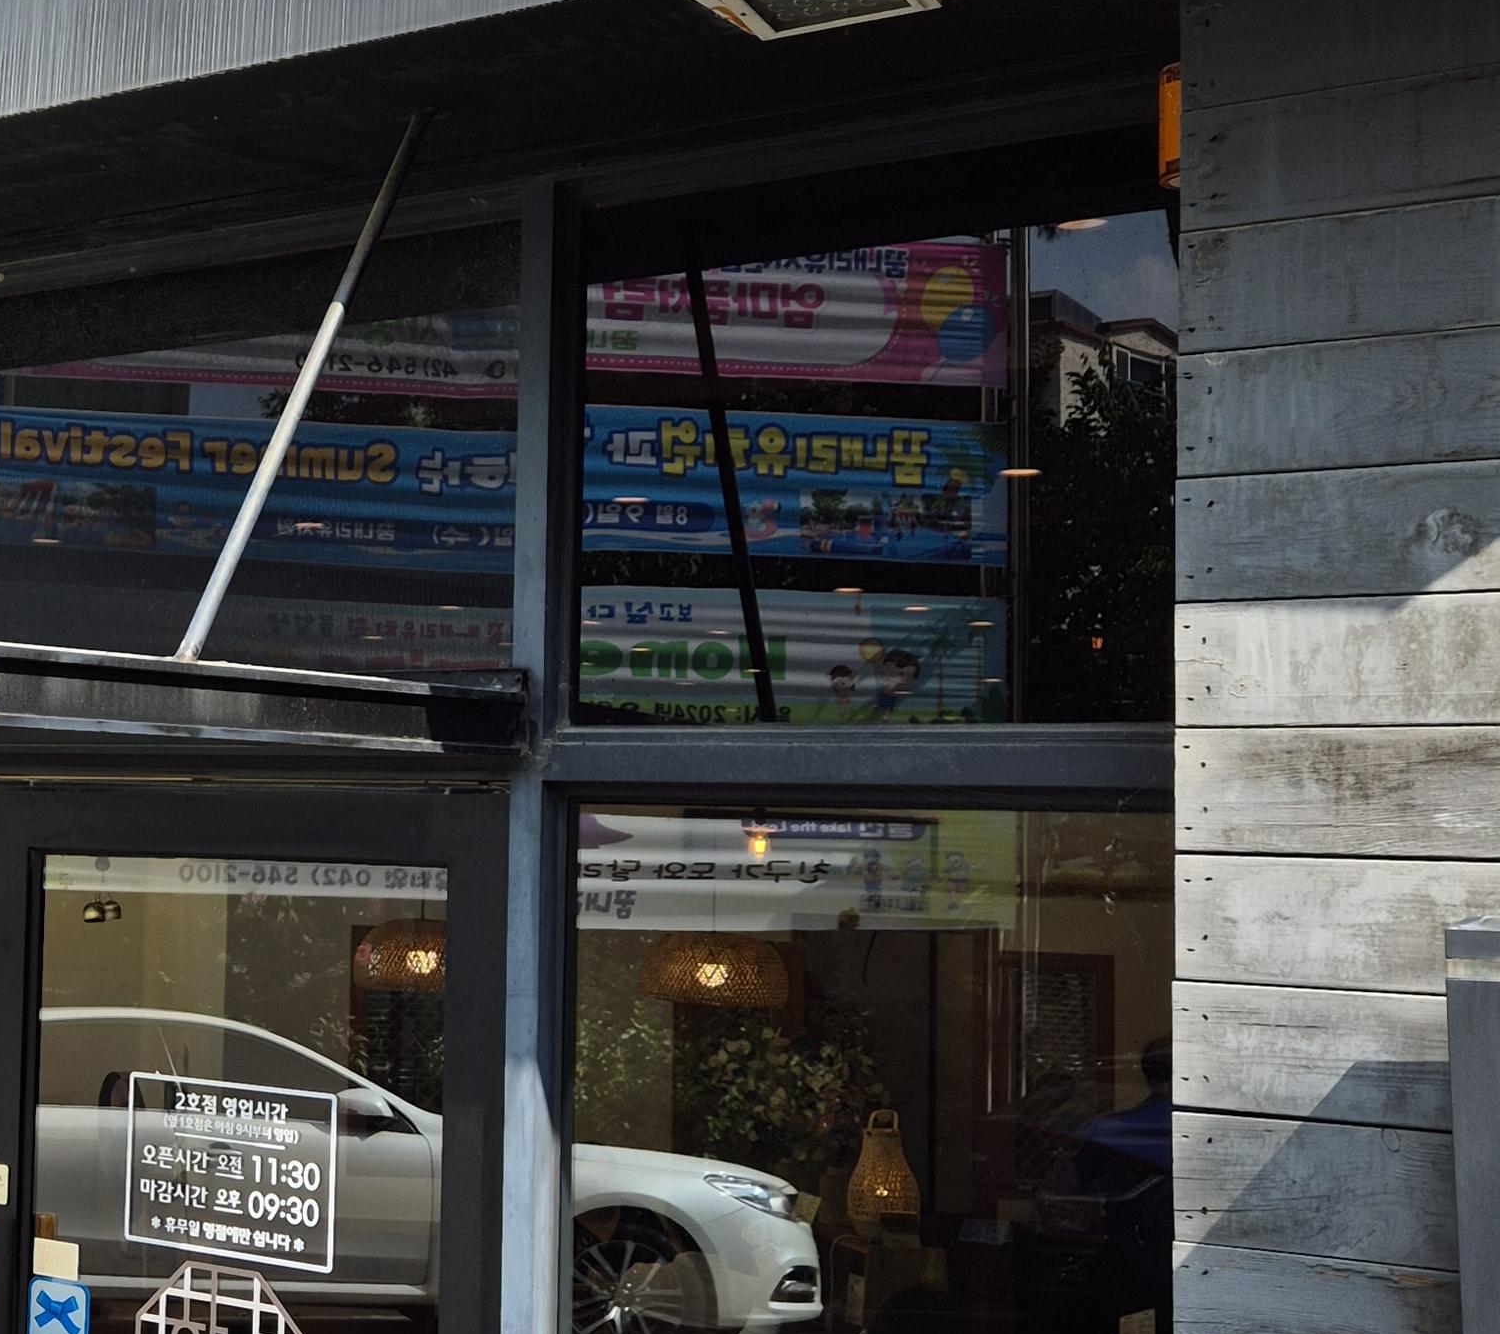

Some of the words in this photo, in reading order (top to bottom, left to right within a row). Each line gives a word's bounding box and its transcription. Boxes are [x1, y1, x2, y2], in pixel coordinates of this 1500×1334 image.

[174, 1092, 218, 1116] 2호점
[221, 1096, 289, 1125] 영업시간
[140, 1144, 210, 1175] 오픈시간
[215, 1154, 243, 1175] 오전
[251, 1154, 322, 1192] 11:30
[139, 1178, 209, 1209] 마감시간
[214, 1188, 242, 1208] 오후
[247, 1190, 320, 1228] 09:30
[163, 1216, 201, 1238] 휴무일
